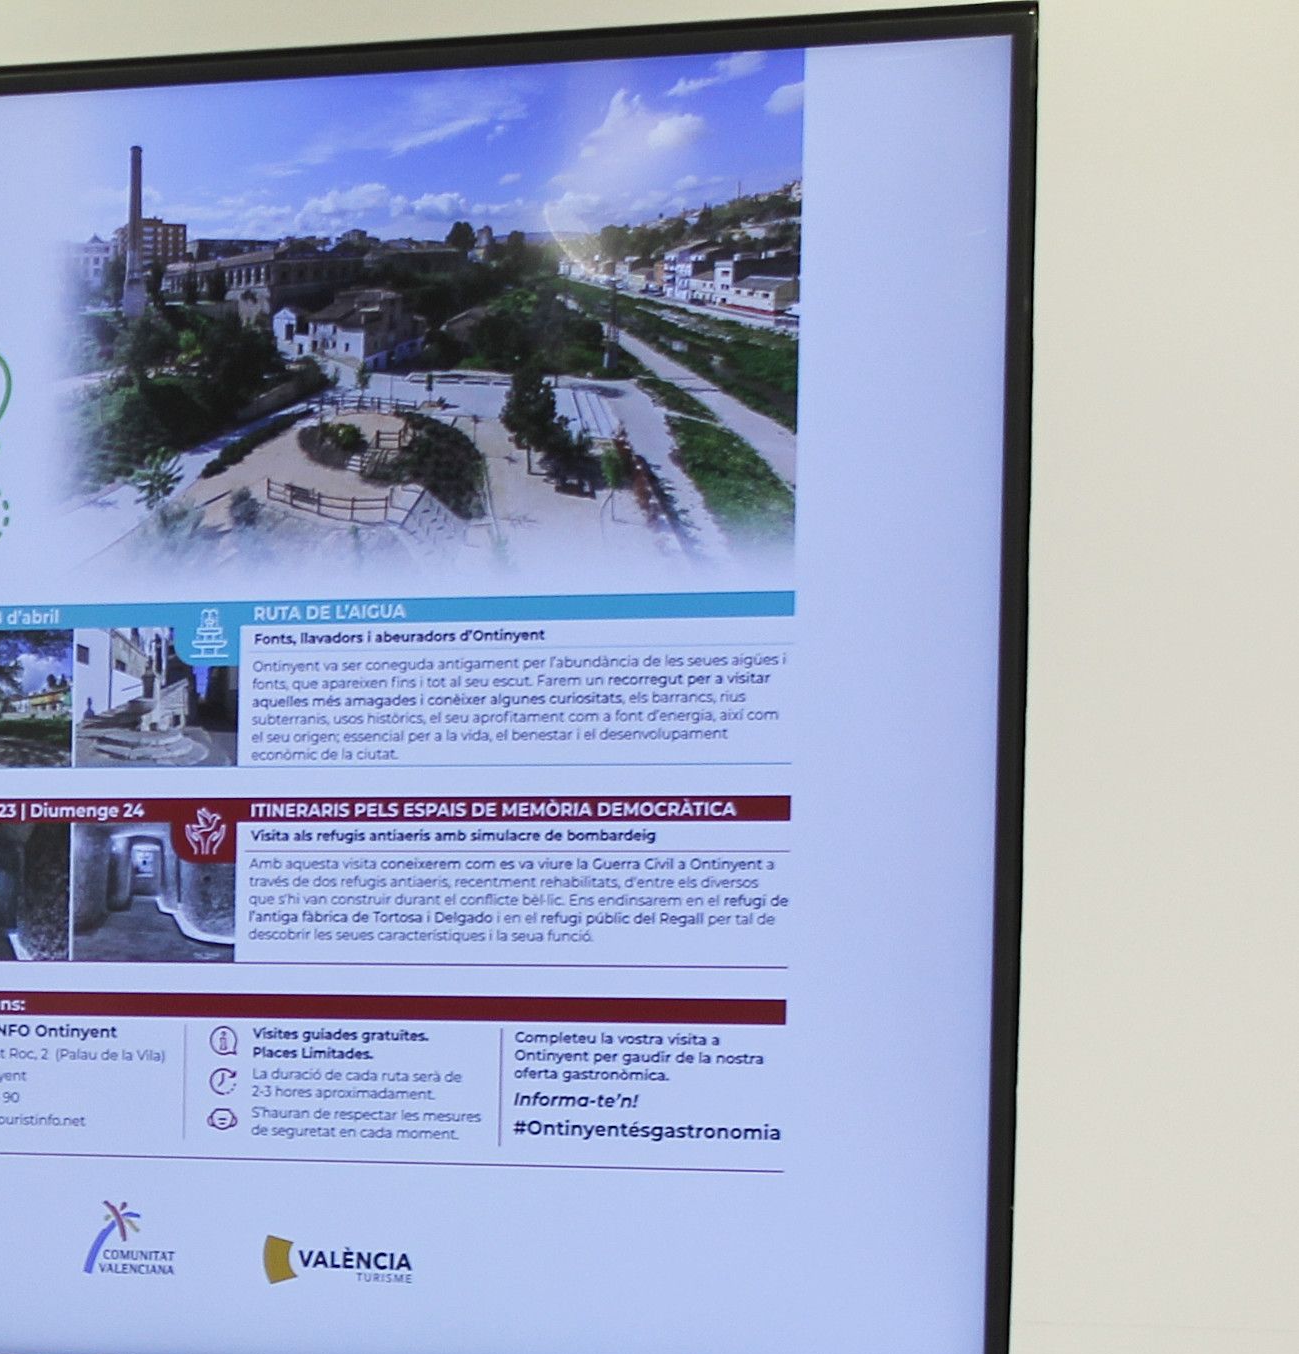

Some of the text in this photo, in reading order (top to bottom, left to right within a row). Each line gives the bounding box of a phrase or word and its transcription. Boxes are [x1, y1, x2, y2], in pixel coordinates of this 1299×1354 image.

[253, 605, 301, 620] RUTA
[306, 604, 331, 619] DE
[254, 633, 296, 645] Fonts,
[300, 631, 363, 643] llavadors
[367, 630, 371, 642] i
[374, 630, 456, 642] abeuradors
[252, 660, 319, 674] Ontinyent
[322, 662, 338, 671] va
[341, 661, 362, 671] ser
[364, 658, 434, 673] coneguda
[437, 658, 519, 672] antigament
[522, 658, 546, 671] per
[642, 654, 661, 667] de
[664, 654, 684, 667] les
[686, 656, 728, 666] seues
[731, 653, 779, 668] aigües
[782, 651, 786, 664] i
[30, 802, 119, 820] Diumenge
[122, 802, 145, 817] 24
[250, 800, 737, 817] ITINERARIS PELS ESPAIS DE MEMÒRIA DEMOCRÀTICA
[250, 828, 656, 844] Visita als refugis antiaeris amb simulacre de bombardeig
[34, 1023, 117, 1040] Ontinyent
[252, 1027, 298, 1039] Visites
[302, 1028, 358, 1042] guiades
[514, 1031, 720, 1046] Completeu la vostra visita a
[9, 1047, 37, 1060] Roc,
[40, 1047, 48, 1060] 2
[55, 1047, 97, 1061] (Palau
[100, 1048, 118, 1061] de
[121, 1049, 133, 1061] la
[135, 1049, 165, 1063] Vila)
[252, 1046, 373, 1059] Places Limitades.
[514, 1048, 764, 1065] Ontinyent per gaudir de la nostra
[513, 1067, 669, 1082] oferta gastronòmica.
[2, 1091, 20, 1103] 90
[512, 1120, 780, 1140] #Ontinyentésgastronomia
[102, 1249, 175, 1262] COMUNITAT
[299, 1247, 412, 1271] VALÈNCIA
[98, 1263, 175, 1275] VALENCIANA
[356, 1272, 412, 1284] TURISME
